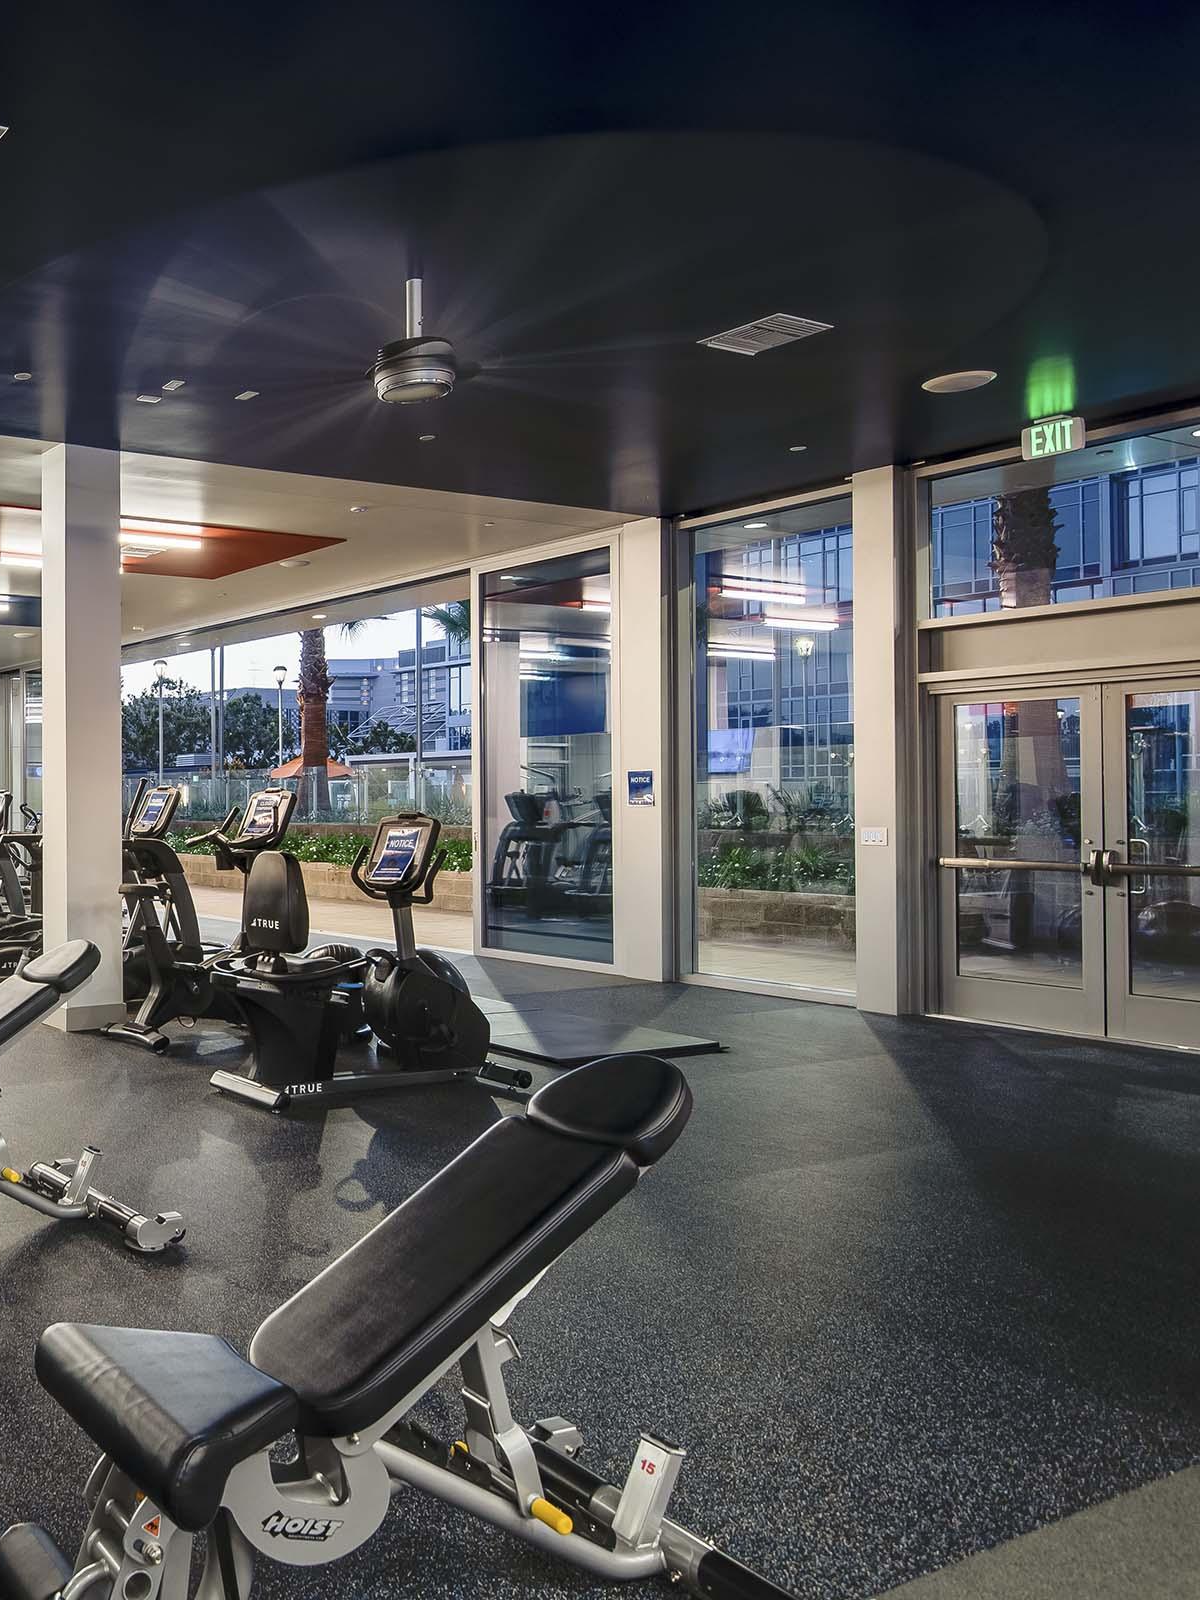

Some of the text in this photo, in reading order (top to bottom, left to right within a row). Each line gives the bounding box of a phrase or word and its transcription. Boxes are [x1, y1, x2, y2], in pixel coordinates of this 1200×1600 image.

[1031, 420, 1073, 456] EXIT
[630, 776, 650, 784] NOTICE
[389, 839, 415, 848] NOTICE
[257, 918, 280, 930] TRUE
[291, 1083, 323, 1094] TRUE
[641, 1459, 656, 1475] 15
[263, 1515, 344, 1537] HOIST
